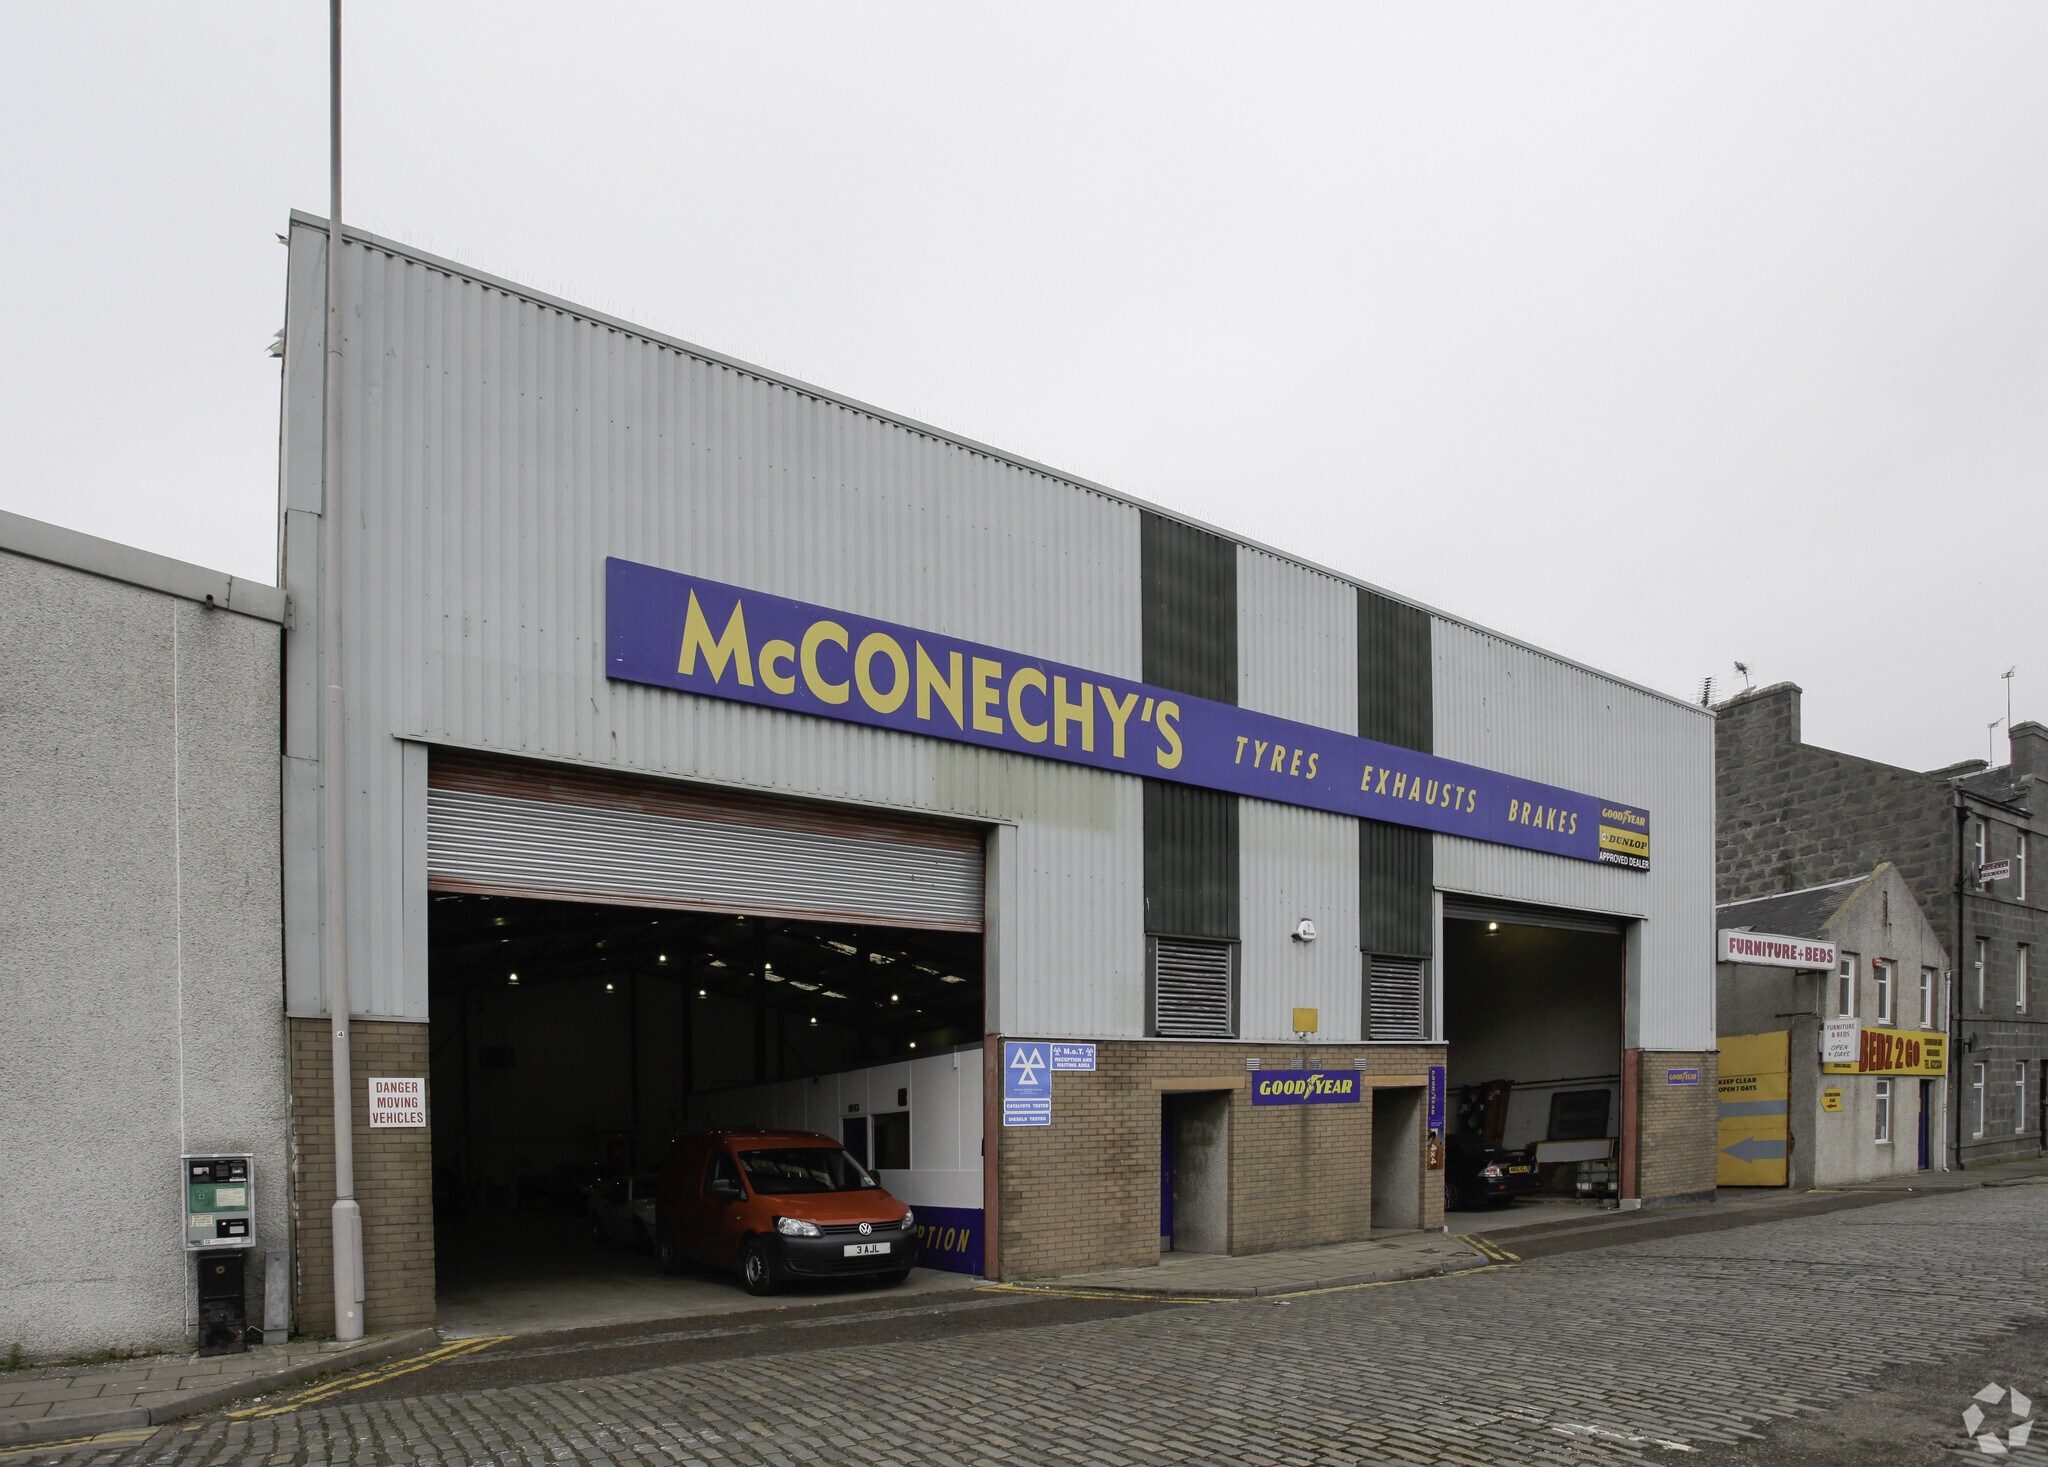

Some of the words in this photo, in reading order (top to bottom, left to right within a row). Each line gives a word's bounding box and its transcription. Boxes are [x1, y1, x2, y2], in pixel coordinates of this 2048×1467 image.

[678, 588, 1183, 770] McCONECHY'S
[1235, 735, 1320, 781] TYRES
[1361, 765, 1477, 814] EXHAUSTS
[1508, 799, 1578, 835] BRAKES
[1602, 808, 1646, 826] GOODYEAR
[1609, 835, 1647, 849] DUNLOP
[1599, 851, 1628, 865] APPROVED
[1629, 856, 1649, 869] DEALER
[1826, 1023, 1855, 1031] FURNITURE
[1859, 1030, 1893, 1073] BEDZ
[1895, 1037, 1904, 1069] 2
[1905, 1038, 1920, 1068] GO
[376, 1081, 418, 1093] DANGER
[1259, 1074, 1354, 1100] GOODYEAR
[377, 1097, 418, 1109] MOVING
[372, 1112, 424, 1124] VEHICLES
[856, 1245, 862, 1254] 3
[863, 1244, 880, 1254] AJL
